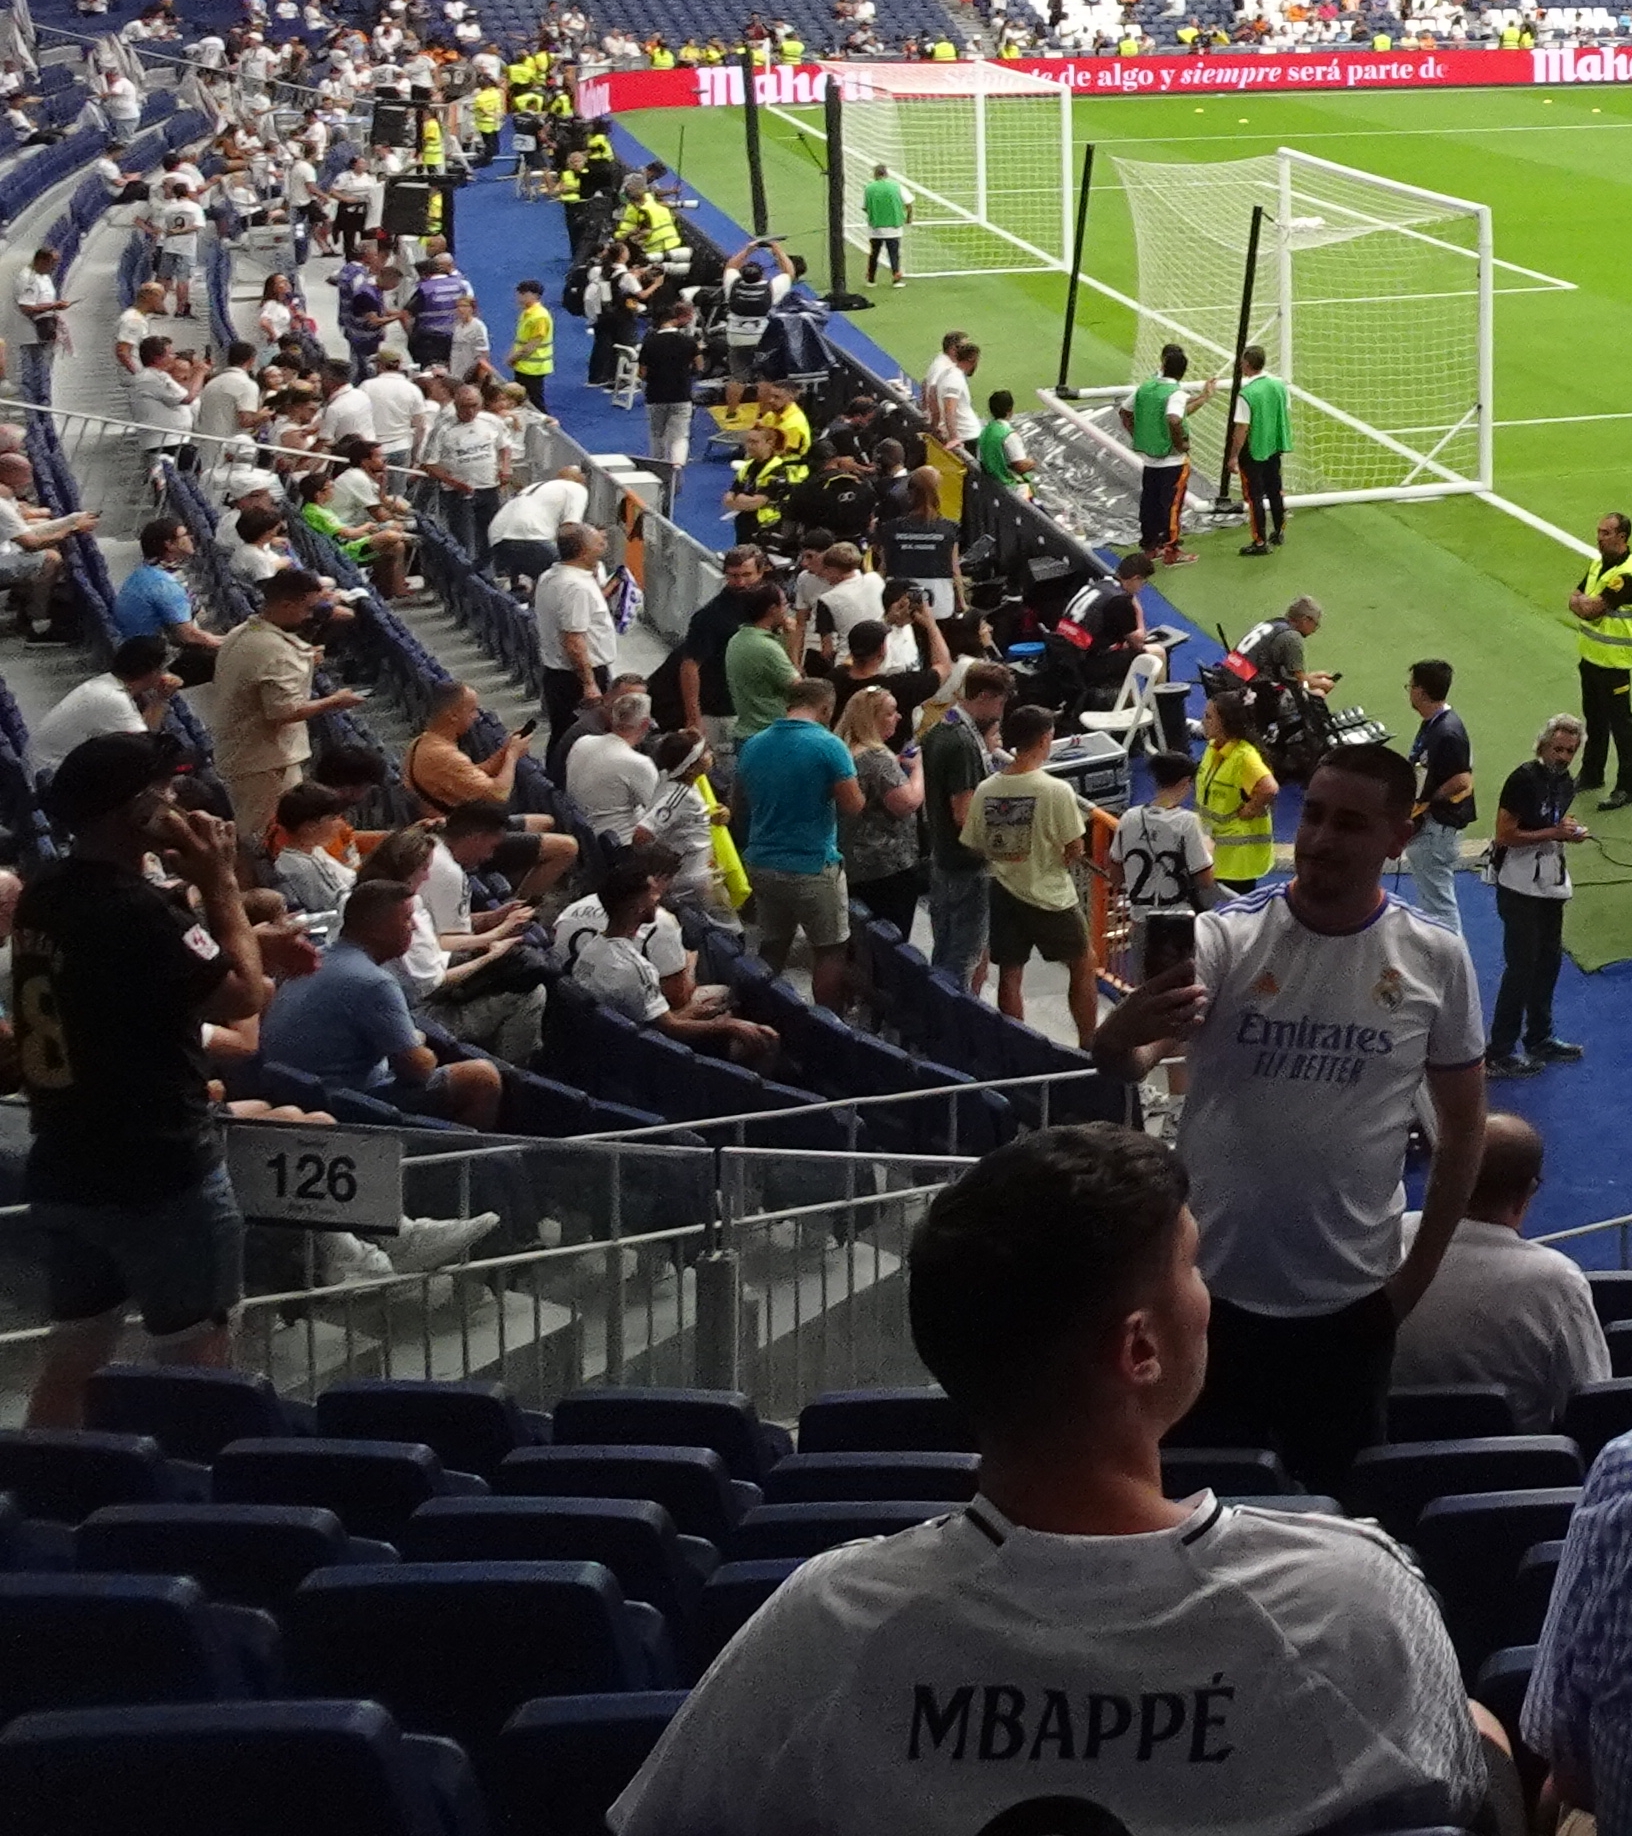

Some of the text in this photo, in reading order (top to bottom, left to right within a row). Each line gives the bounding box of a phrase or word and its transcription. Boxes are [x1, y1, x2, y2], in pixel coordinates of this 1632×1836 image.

[1059, 64, 1091, 89] de
[1098, 63, 1154, 92] algo
[1160, 69, 1176, 90] y
[1180, 62, 1282, 89] siempre
[1287, 58, 1341, 82] será
[1347, 61, 1413, 86] parte
[1125, 848, 1188, 906] 23
[1236, 1013, 1393, 1055] Emirates
[266, 1152, 358, 1203] 126
[906, 1671, 1238, 1764] MBAPPÉ
